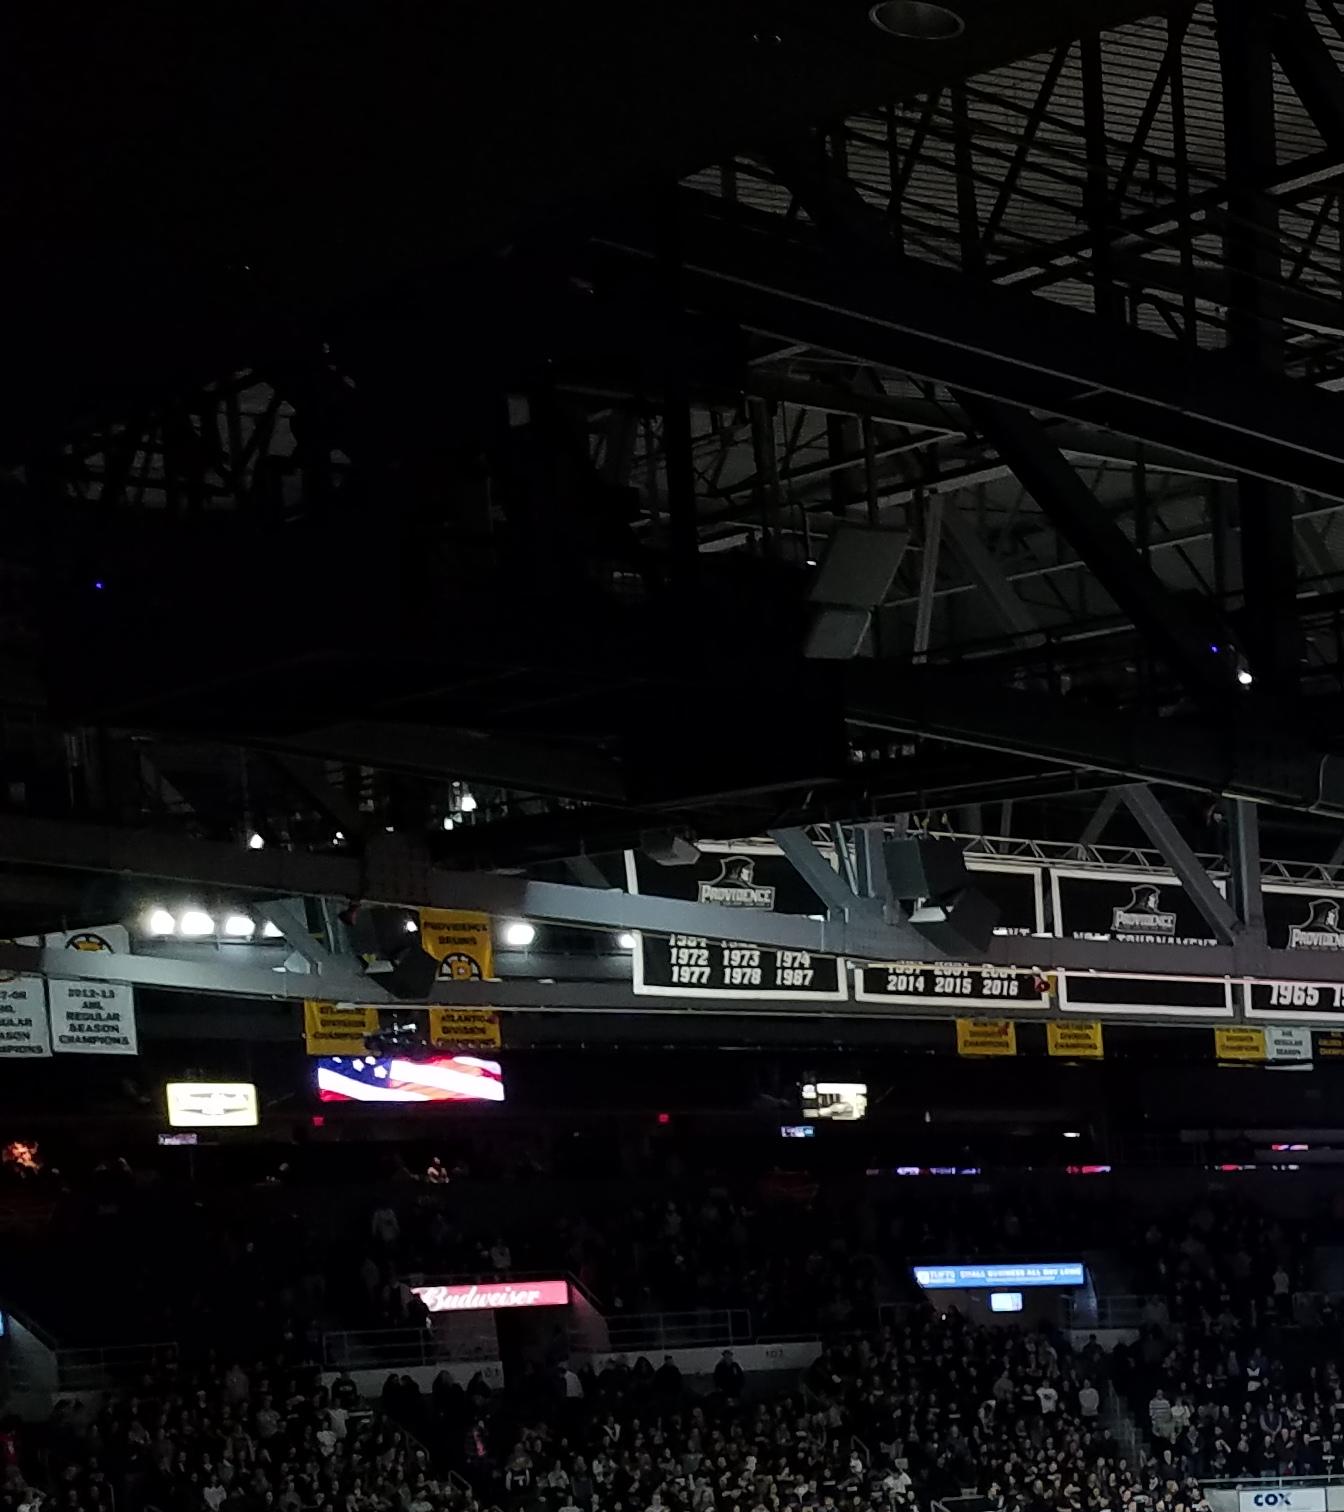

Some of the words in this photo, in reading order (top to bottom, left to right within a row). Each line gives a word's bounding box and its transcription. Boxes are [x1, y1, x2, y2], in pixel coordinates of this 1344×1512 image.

[701, 885, 773, 905] PROVIDENCE
[670, 948, 709, 966] 1972
[723, 949, 761, 967] 1973
[776, 951, 811, 968] 1974
[671, 966, 711, 984] 1977
[723, 968, 762, 985] 1978
[776, 969, 814, 986] 1987
[887, 975, 924, 992] 2014
[934, 978, 972, 994] 2015
[982, 980, 1018, 996] 2016
[1270, 983, 1319, 1006] 1965
[69, 1024, 120, 1034] SEASON
[422, 1286, 540, 1311] Budweiser
[1254, 1491, 1292, 1507] COX
